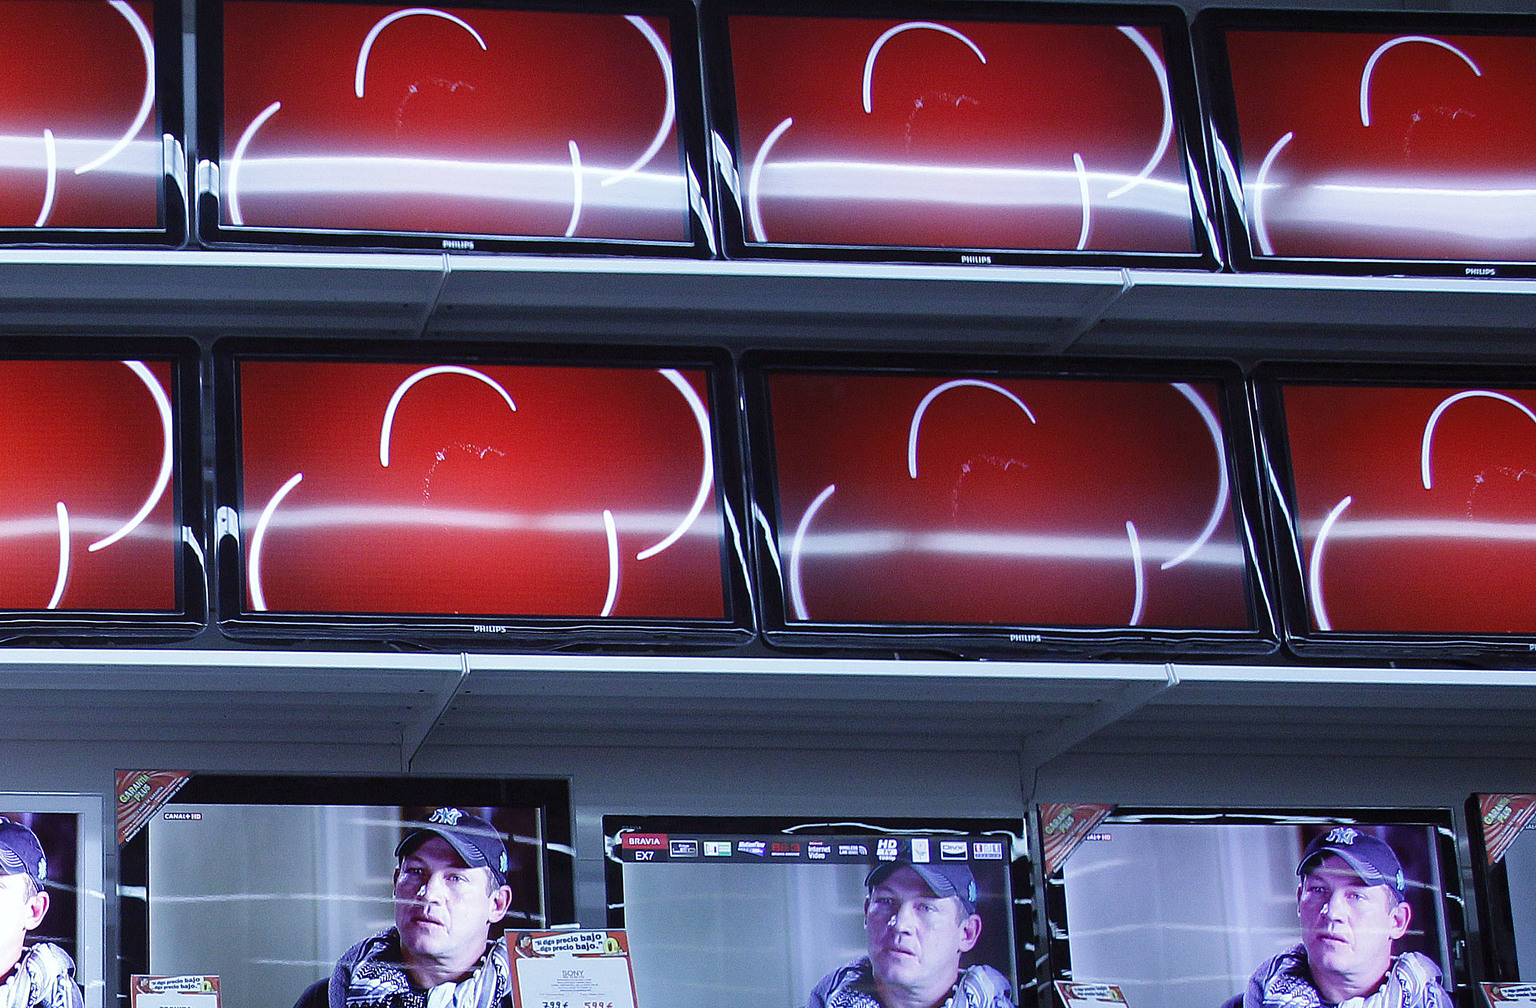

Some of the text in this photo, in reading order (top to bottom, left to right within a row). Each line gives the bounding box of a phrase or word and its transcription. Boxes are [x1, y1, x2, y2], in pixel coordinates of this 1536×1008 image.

[442, 240, 475, 250] PHILIPS
[961, 255, 991, 264] PHILIPS
[1465, 267, 1496, 276] PHILIPS
[473, 625, 507, 633] PHILIPS
[1009, 634, 1042, 643] PHILIPS
[877, 839, 898, 849] HD
[635, 851, 654, 861] EX7
